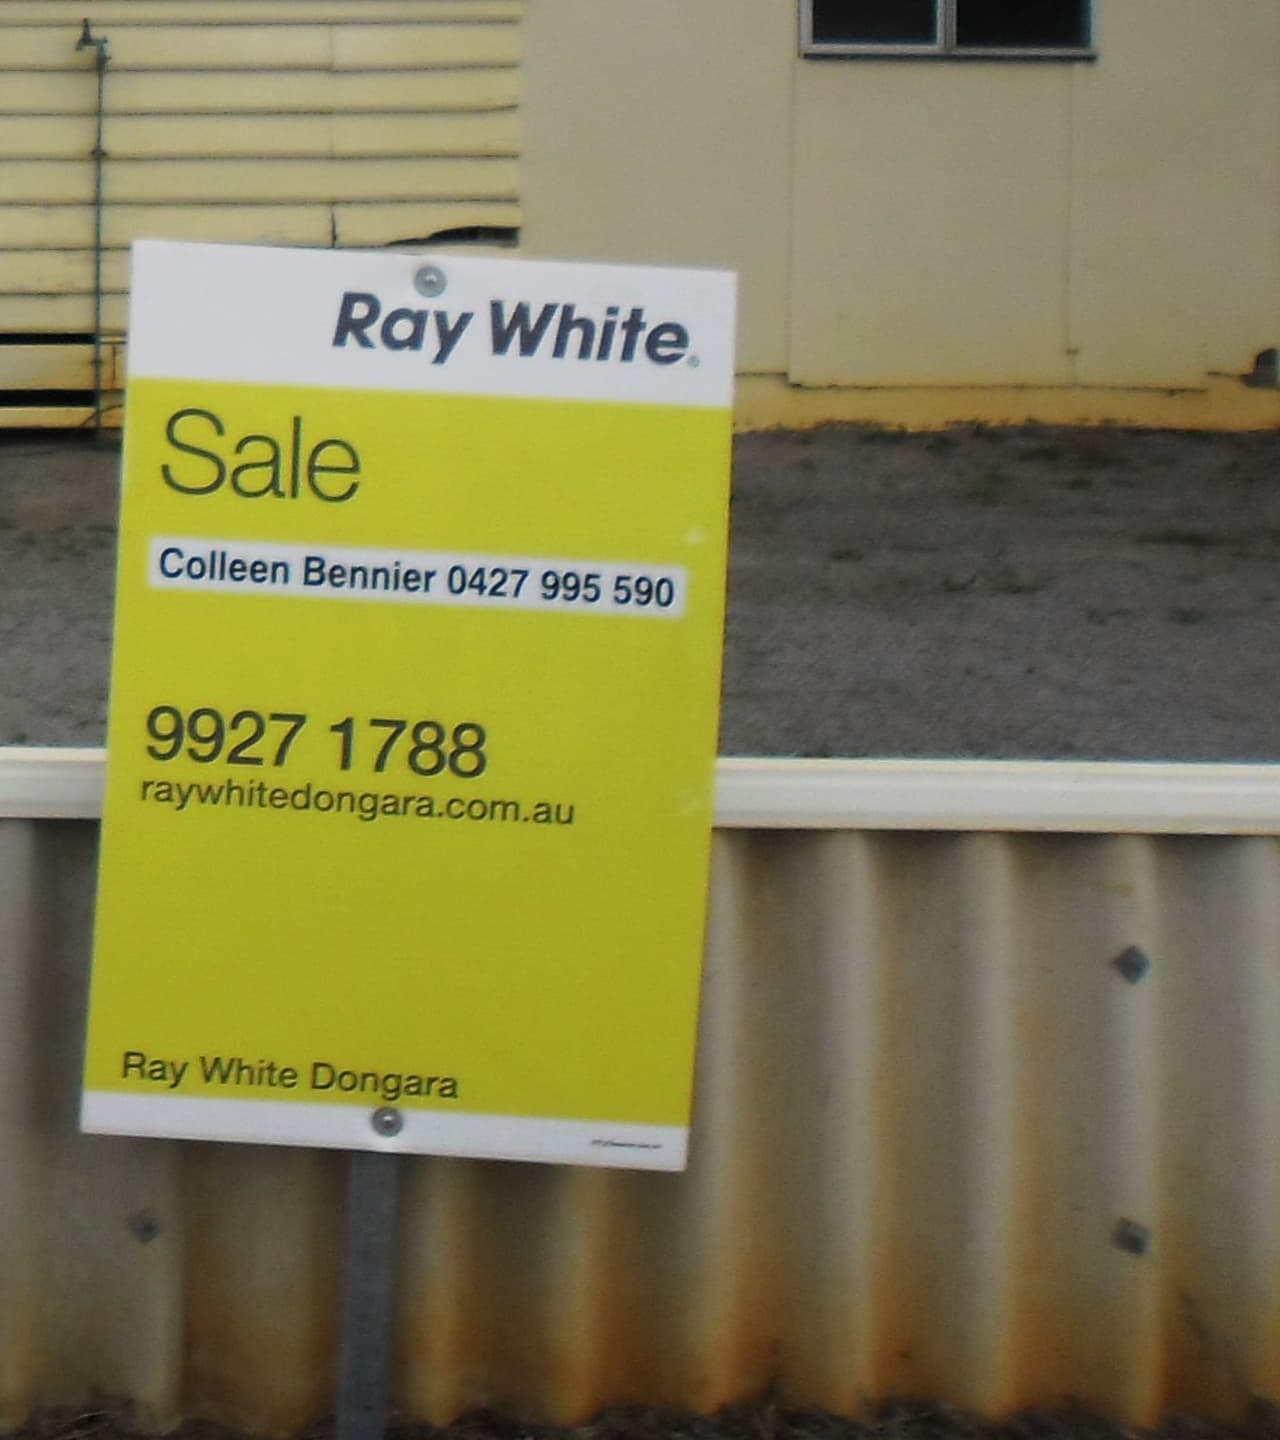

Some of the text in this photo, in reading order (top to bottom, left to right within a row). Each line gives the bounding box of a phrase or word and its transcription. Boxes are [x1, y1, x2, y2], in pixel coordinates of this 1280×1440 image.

[332, 291, 473, 365] Ray
[161, 408, 361, 503] Sale
[159, 547, 674, 607] Colleen Bennier 0427 995 590
[146, 705, 487, 779] 9927 1788
[141, 776, 576, 825] raywhitedongara.com.au
[121, 1051, 459, 1102] Ray White Dongara
